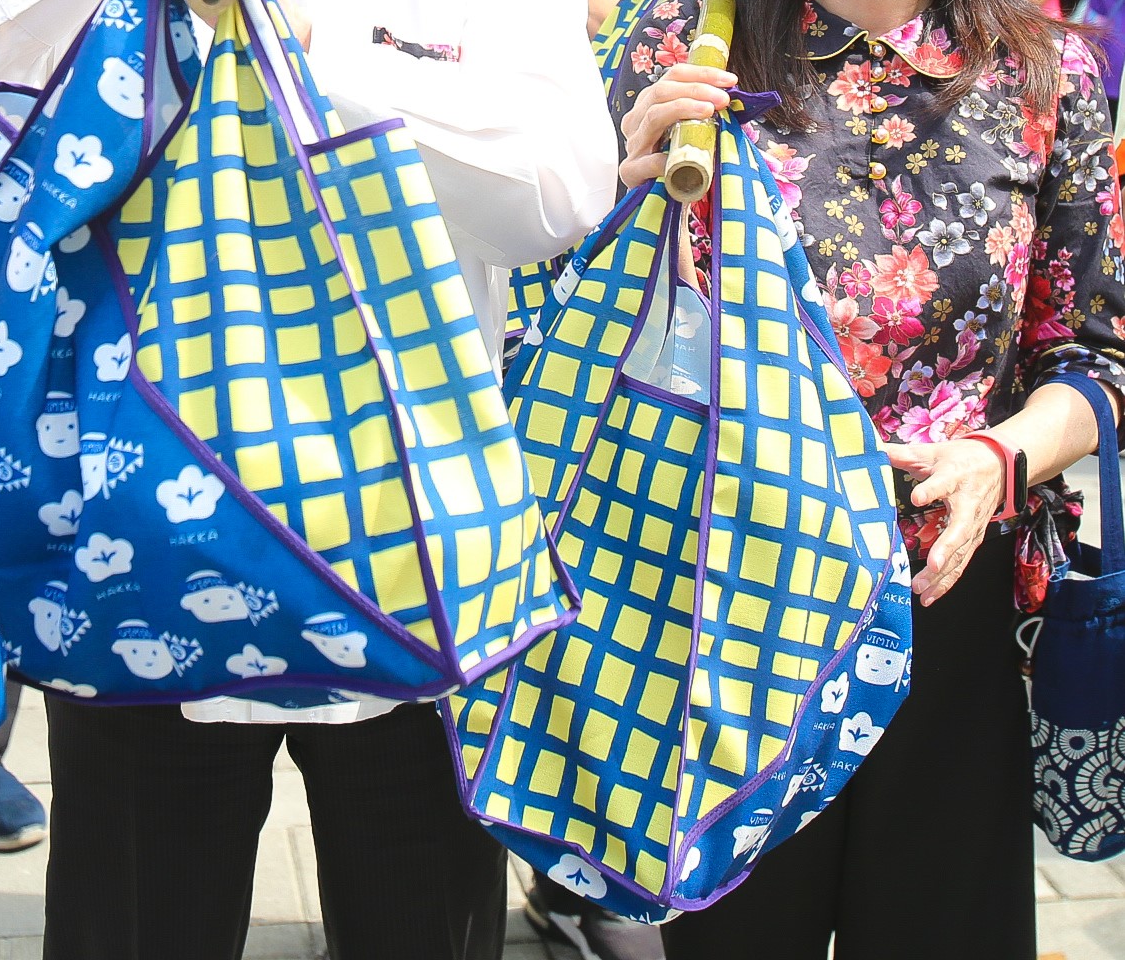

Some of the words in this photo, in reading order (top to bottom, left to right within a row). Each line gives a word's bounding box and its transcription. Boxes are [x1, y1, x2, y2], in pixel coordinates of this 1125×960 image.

[168, 530, 219, 546] HAKKA
[883, 591, 912, 604] AKKA
[866, 634, 900, 650] YIMIN
